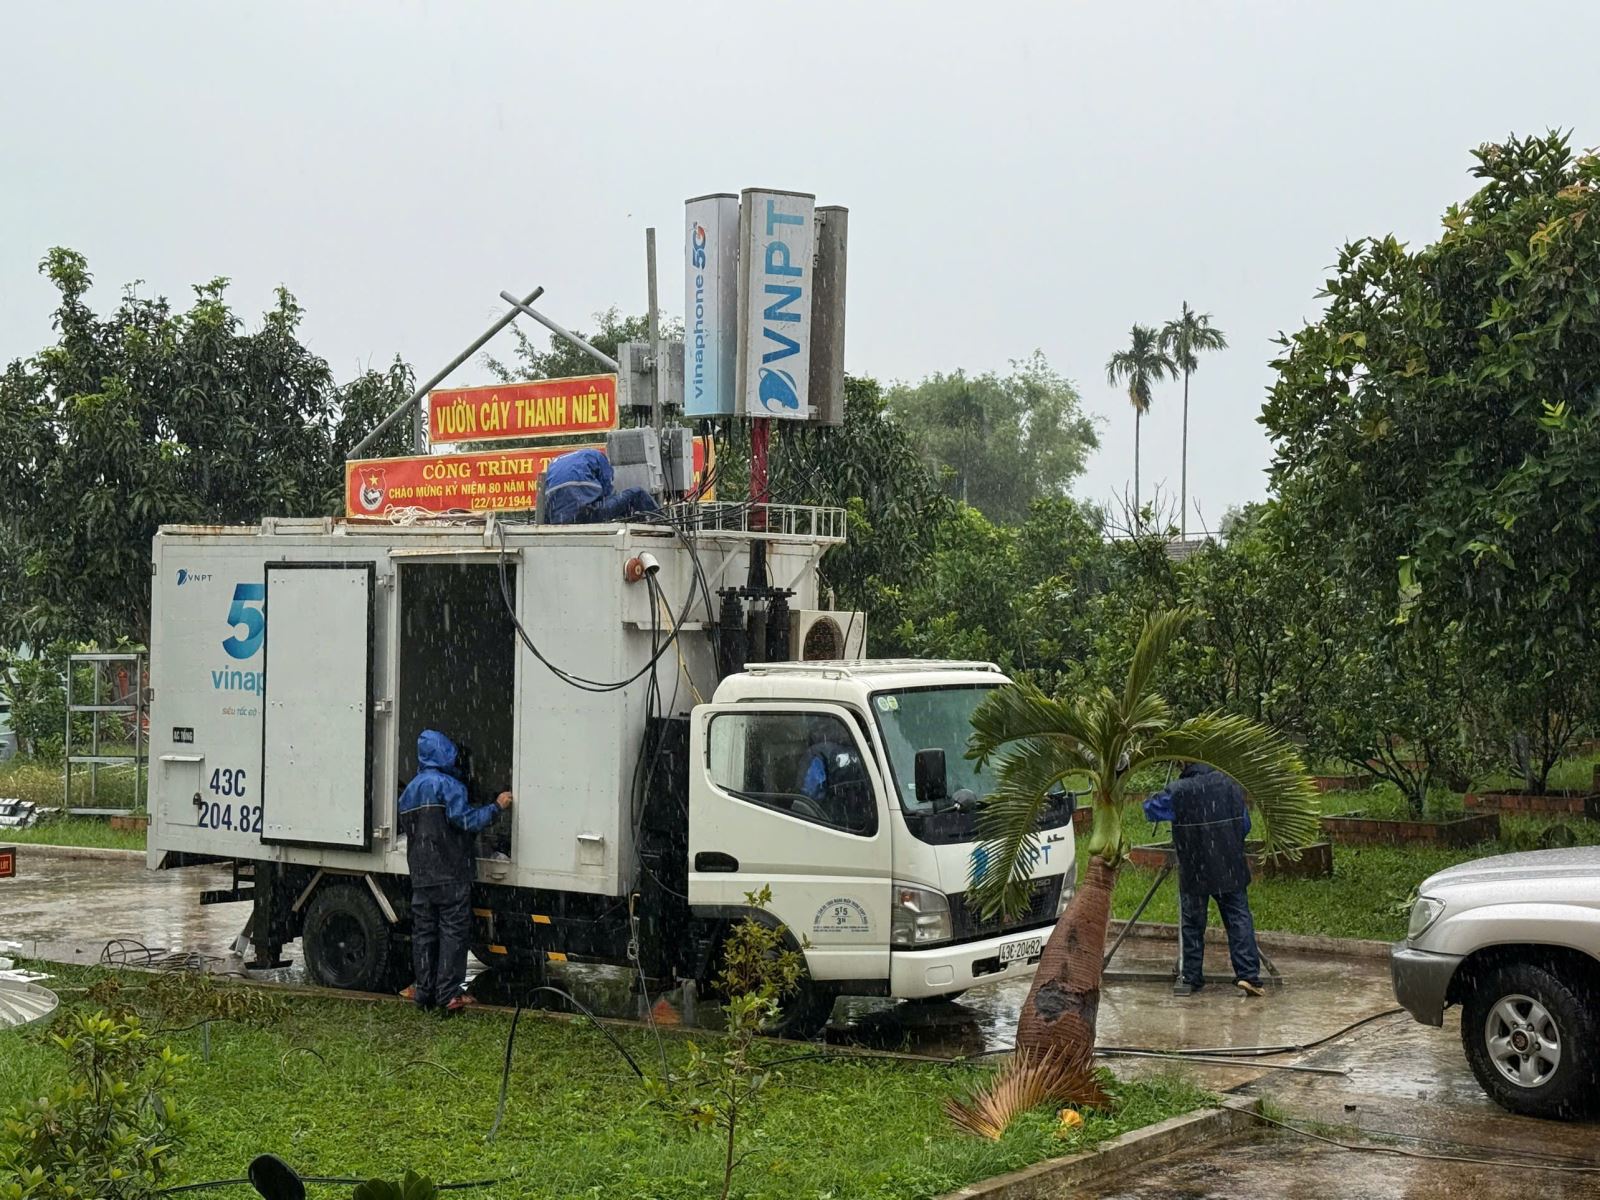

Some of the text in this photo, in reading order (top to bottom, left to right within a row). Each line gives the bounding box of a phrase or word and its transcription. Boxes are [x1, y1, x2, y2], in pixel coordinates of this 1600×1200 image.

[762, 199, 804, 365] VNPT
[690, 275, 705, 399] vinaphone
[437, 386, 609, 434] VƯỜN CÂY THANH NIÊN
[422, 460, 471, 480] CÔNG
[477, 456, 533, 477] TRÌNH
[388, 485, 413, 499] CHÀO
[461, 482, 485, 497] NIỆM
[488, 482, 500, 494] 80
[504, 480, 525, 493] NĂM
[188, 574, 213, 582] VNPT
[209, 768, 246, 797] 43C
[198, 801, 262, 833] 204.82
